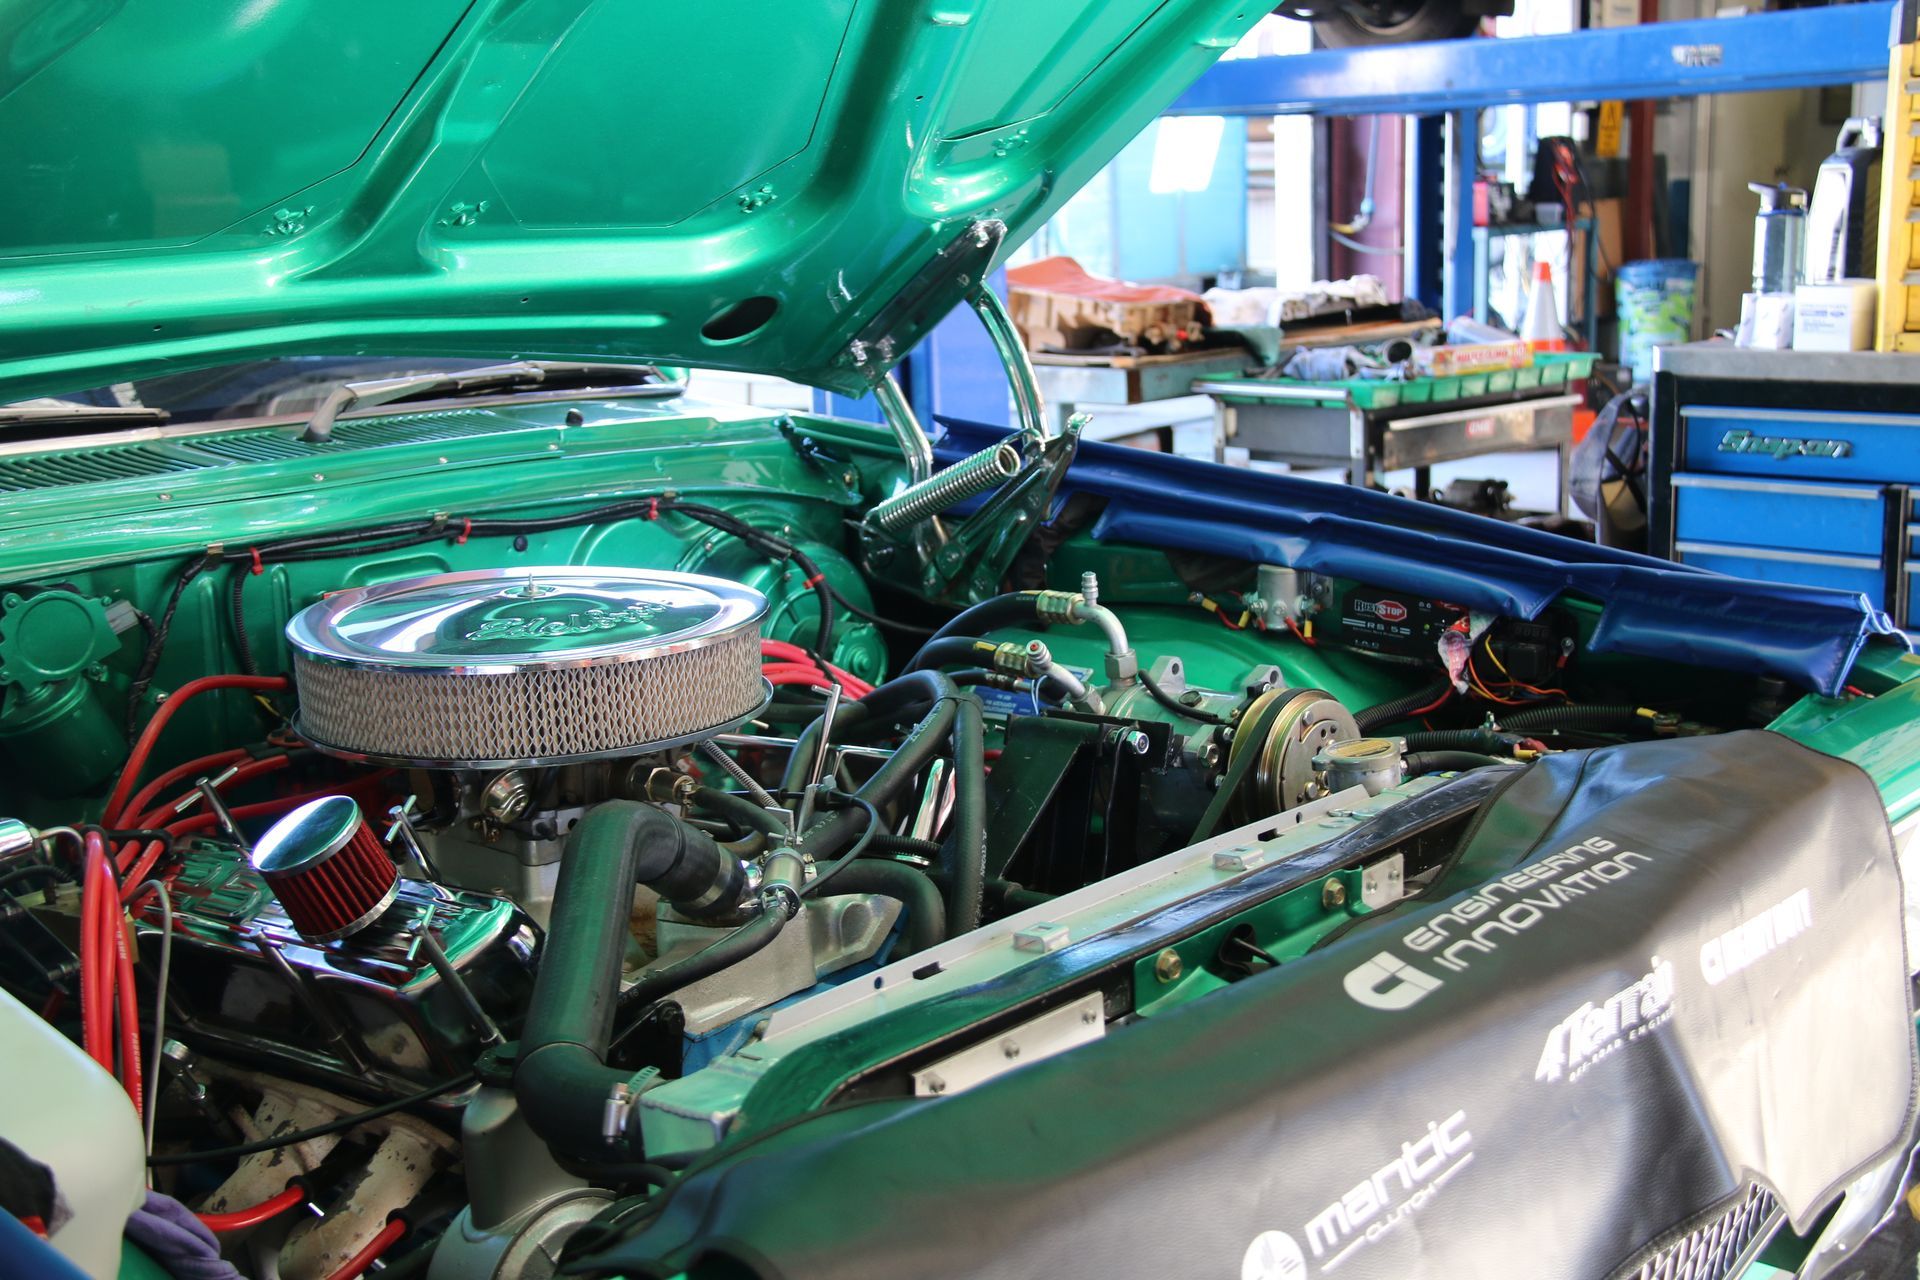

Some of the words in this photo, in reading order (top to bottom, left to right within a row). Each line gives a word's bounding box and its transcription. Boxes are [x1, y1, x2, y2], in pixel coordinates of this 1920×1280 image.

[1718, 429, 1854, 461] Snap-on
[1403, 836, 1617, 951] ENGINEERING
[1433, 851, 1653, 972] INNOVATION
[1304, 1109, 1472, 1258] mantic
